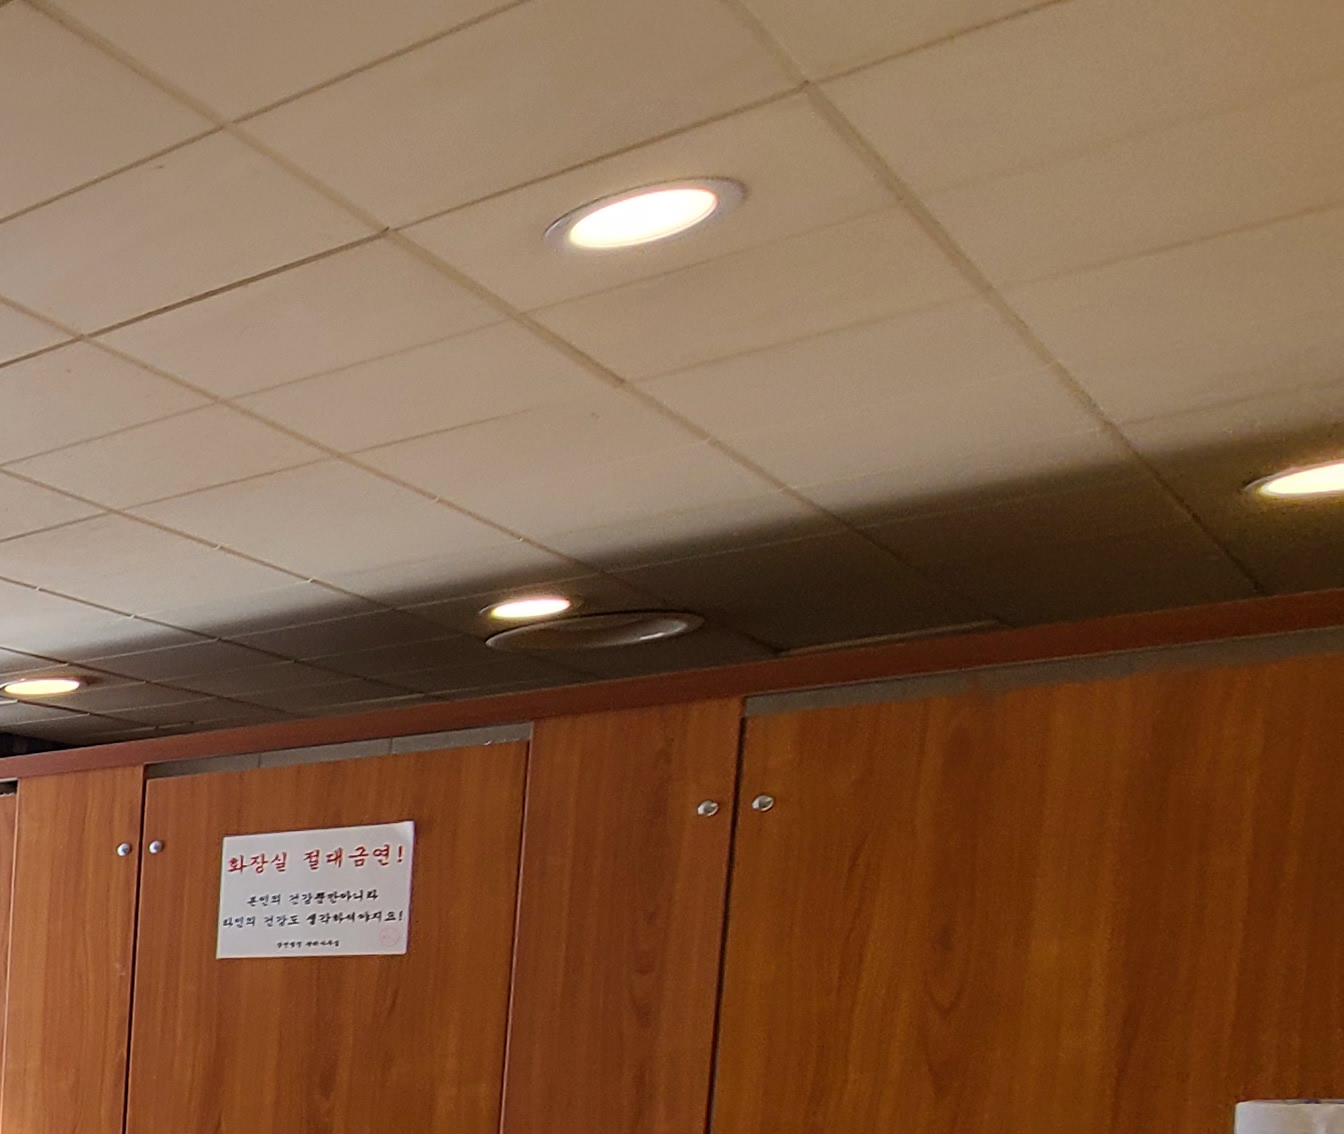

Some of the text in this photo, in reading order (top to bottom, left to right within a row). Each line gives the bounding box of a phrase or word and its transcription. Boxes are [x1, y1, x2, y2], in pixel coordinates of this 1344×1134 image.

[226, 844, 404, 874] 화장실 절대금연!
[247, 894, 281, 907] 본인의
[223, 915, 256, 929] 타인의
[264, 914, 300, 927] 건강도
